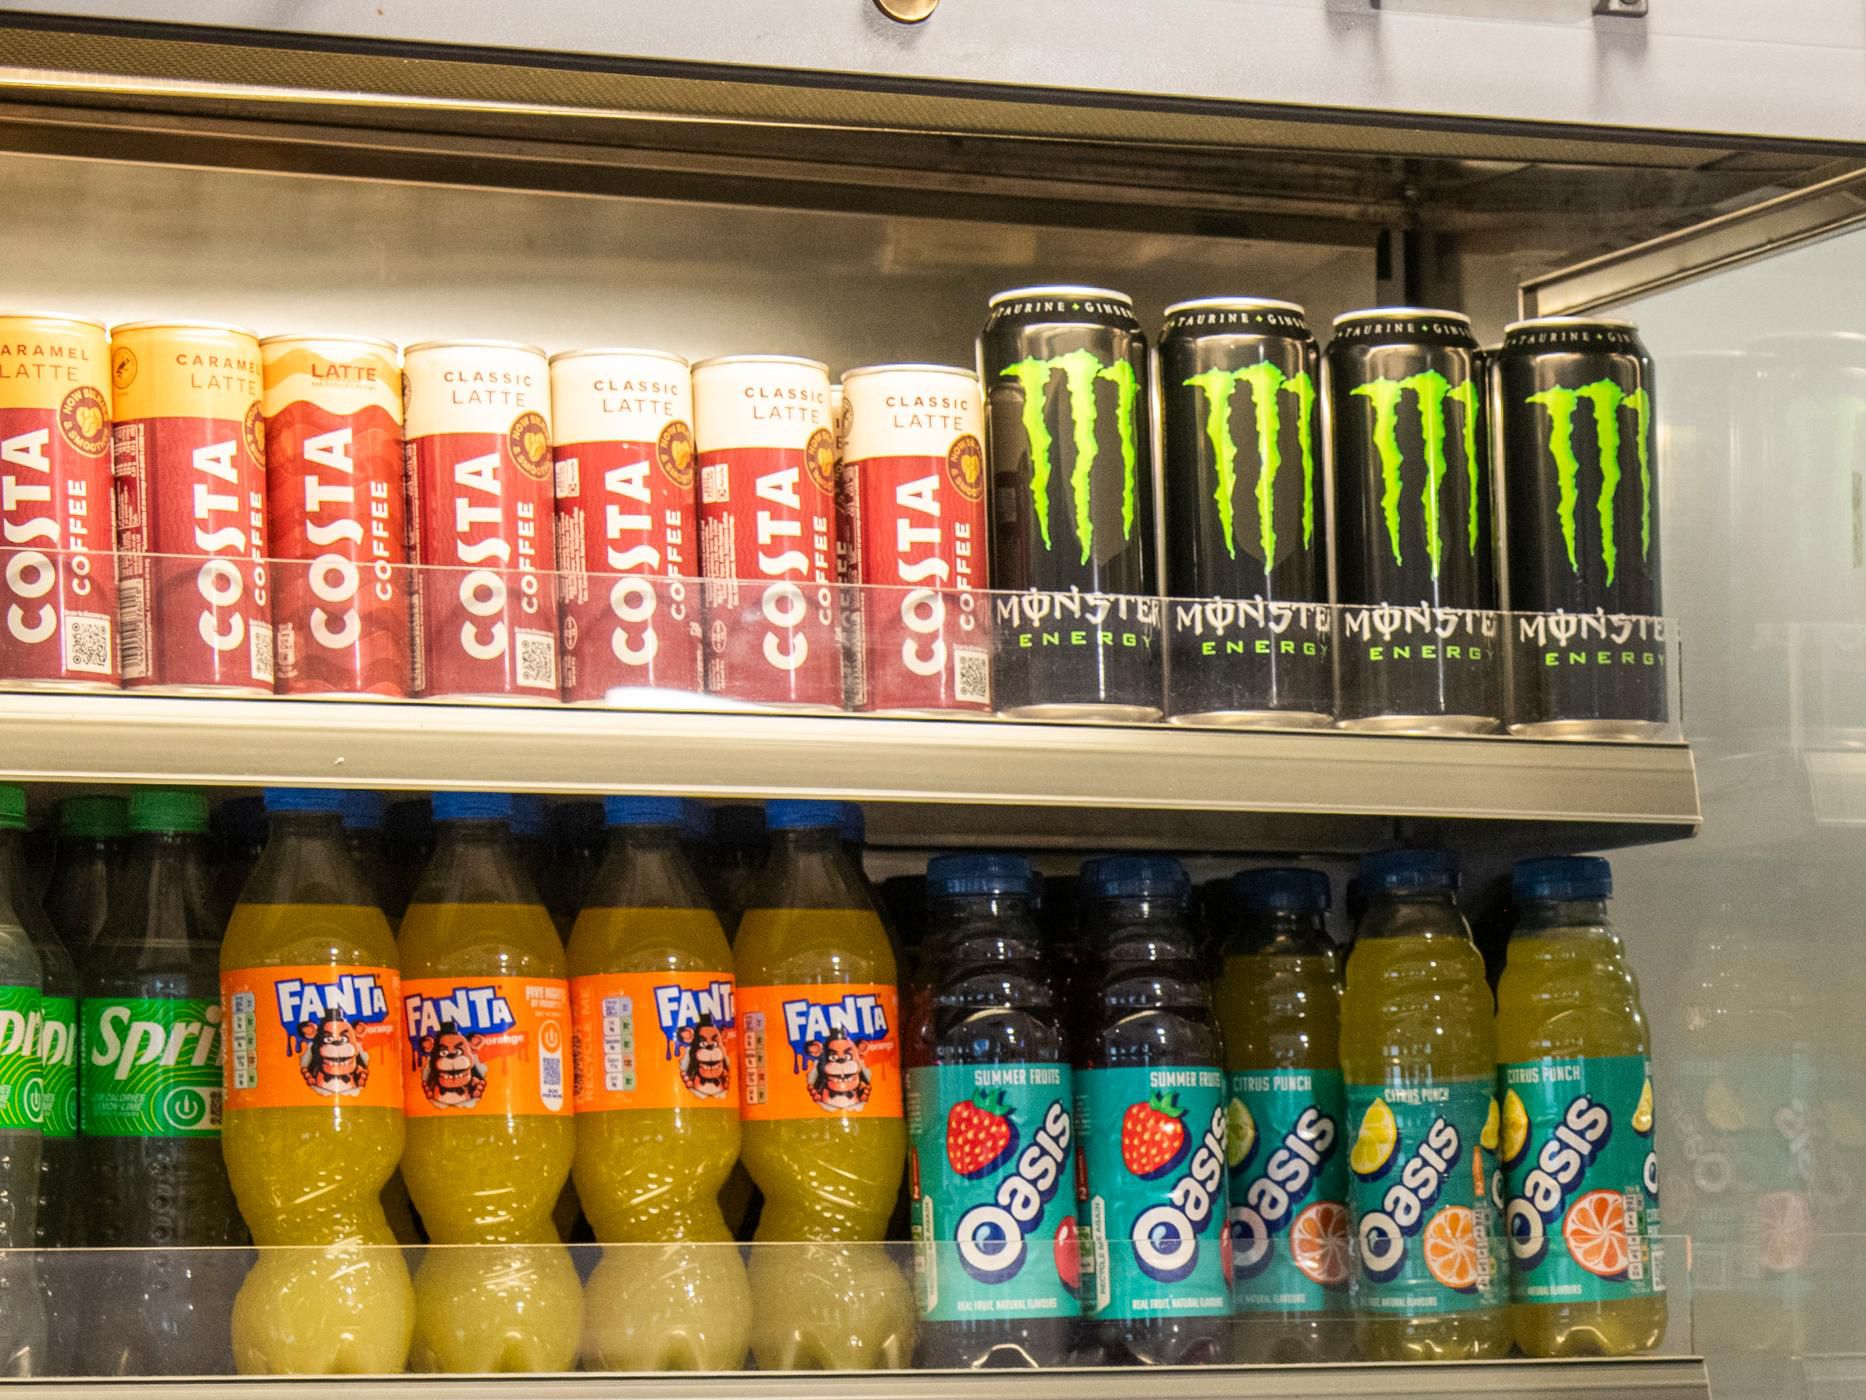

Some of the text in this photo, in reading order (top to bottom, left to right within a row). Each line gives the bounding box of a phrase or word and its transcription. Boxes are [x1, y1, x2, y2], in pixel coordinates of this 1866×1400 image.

[997, 301, 1066, 318] TAURINE
[1177, 312, 1250, 328] TAURINE
[1344, 322, 1415, 339] TAURINE
[0, 344, 89, 361] ARAMEL
[1518, 331, 1591, 346] TAURINE
[0, 363, 79, 382] LATTE
[176, 353, 261, 376] CARAMEL
[191, 374, 256, 396] LATTE
[311, 363, 377, 382] LATTE
[443, 370, 533, 388] CLASSIC
[451, 389, 526, 408] LATTE
[593, 379, 678, 397] CLASSIC
[602, 398, 673, 417] LATTE
[744, 386, 824, 404] CLASSIC
[886, 396, 969, 411] CLASSIC
[752, 405, 820, 425] LATTE
[893, 414, 963, 432] LATTE
[1, 428, 61, 644] COSTA
[68, 480, 92, 597] COFFEE
[193, 440, 247, 652] COSTA
[249, 491, 268, 607] COFFEE
[303, 427, 364, 649] COSTA
[370, 480, 393, 602] COFFEE
[454, 452, 512, 660] COSTA
[517, 501, 540, 614] COFFEE
[604, 460, 661, 666] COSTA
[665, 509, 686, 622] COFFEE
[755, 466, 810, 670] COSTA
[812, 515, 833, 626] COFFEE
[896, 474, 950, 676] COSTA
[954, 522, 976, 631] COFFEE
[997, 584, 1161, 630] MONSTER
[1176, 594, 1331, 637] MONSTE
[1344, 600, 1499, 642] MONSTE
[1518, 606, 1668, 648] MONSTE
[1019, 630, 1151, 649] ENERGY
[277, 975, 388, 1024] FANTA
[405, 987, 515, 1037] FANTA
[784, 993, 888, 1043] FANTA
[92, 1005, 223, 1081] Spri
[974, 1069, 1026, 1087] SUMMER
[1150, 1071, 1197, 1088] SUMMER
[1233, 1076, 1312, 1092] CITRUS PUNCH
[1384, 1087, 1450, 1104] CITRUS PUNCH
[1507, 1065, 1582, 1084] CITRUS PUNCH
[956, 1102, 1071, 1272] Oasis
[1132, 1106, 1227, 1271] Oasis
[1231, 1107, 1336, 1268] Oasis
[1359, 1117, 1460, 1272] Oasis
[1506, 1096, 1609, 1259] Oasis
